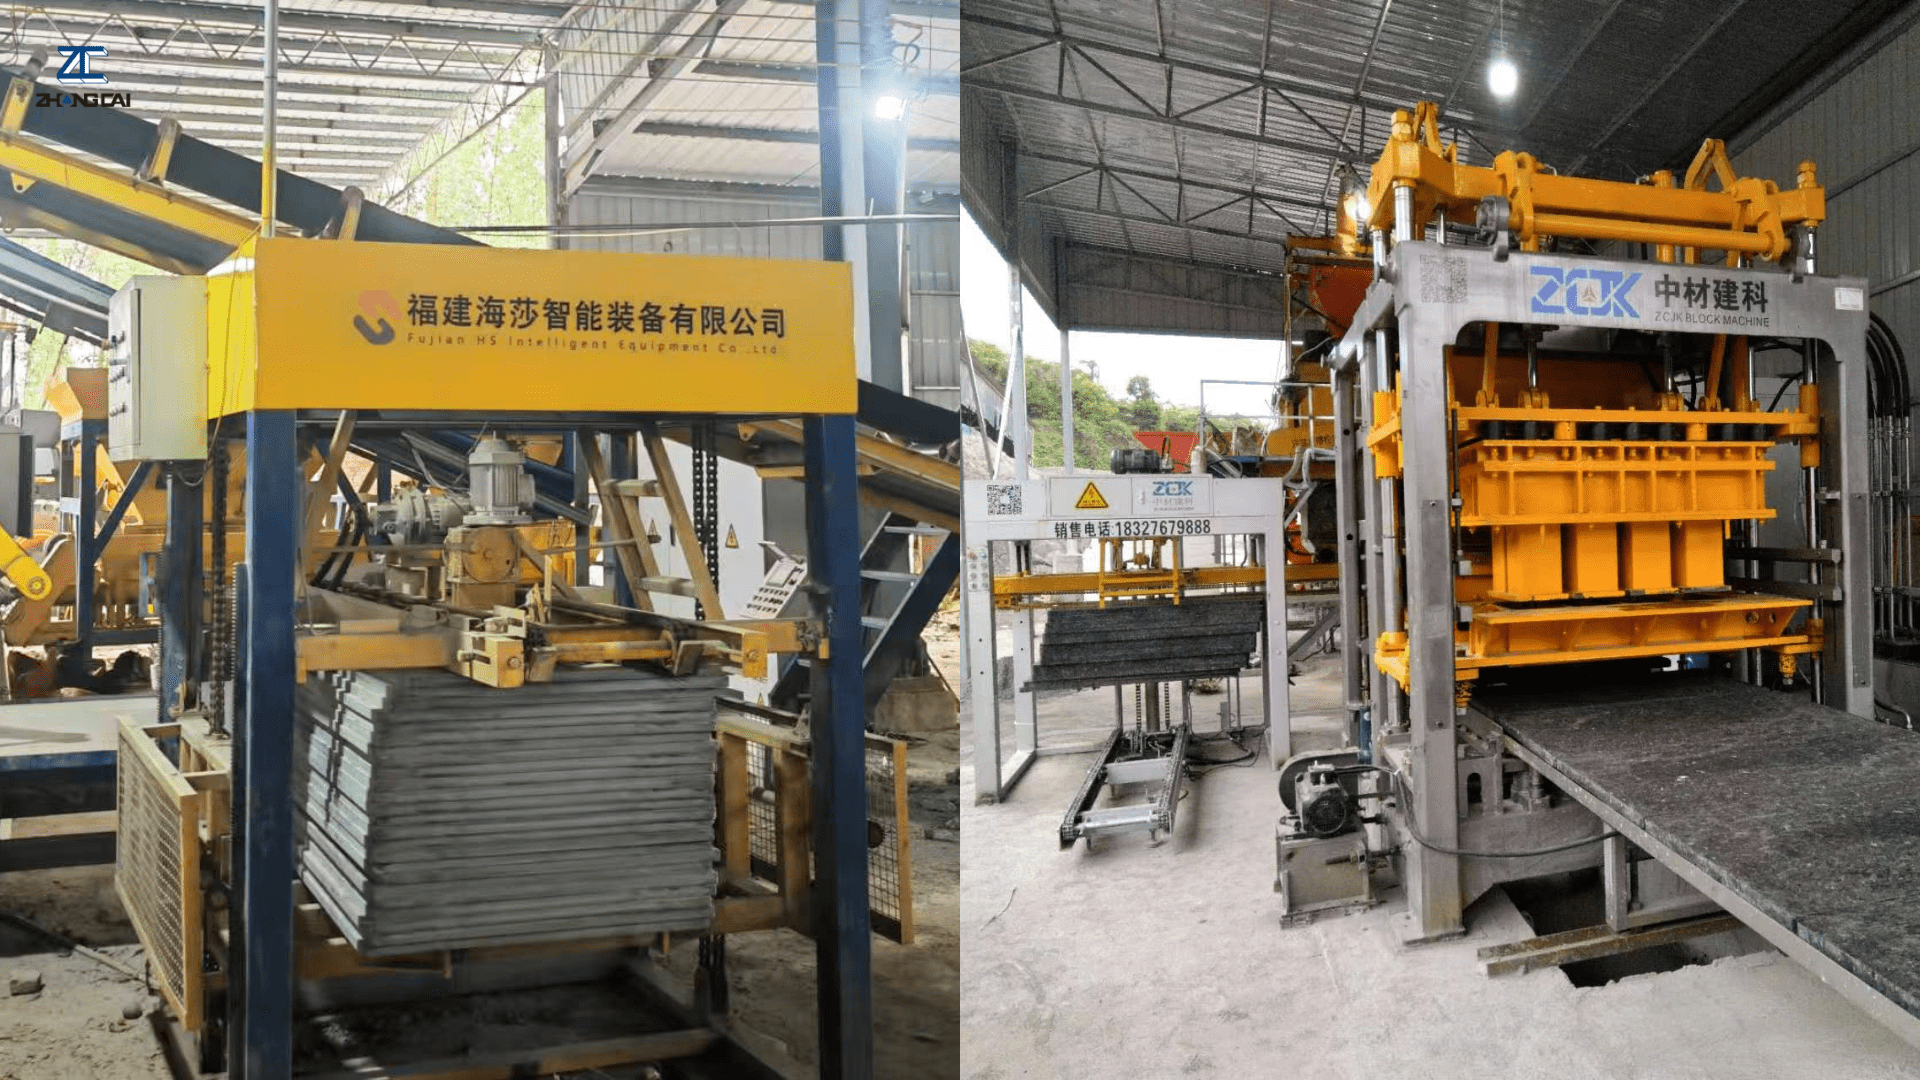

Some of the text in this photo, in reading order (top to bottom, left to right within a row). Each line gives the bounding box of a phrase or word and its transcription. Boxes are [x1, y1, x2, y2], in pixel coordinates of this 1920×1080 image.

[1655, 274, 1769, 313] 中材建科
[408, 294, 785, 338] 福建海莎智能装备有限公司
[1655, 311, 1770, 328] ZCJK BLOCK MACHINE
[407, 333, 465, 346] Fujian
[477, 336, 498, 346] HS
[509, 336, 608, 351] Intelligent
[618, 340, 708, 353] Equipment
